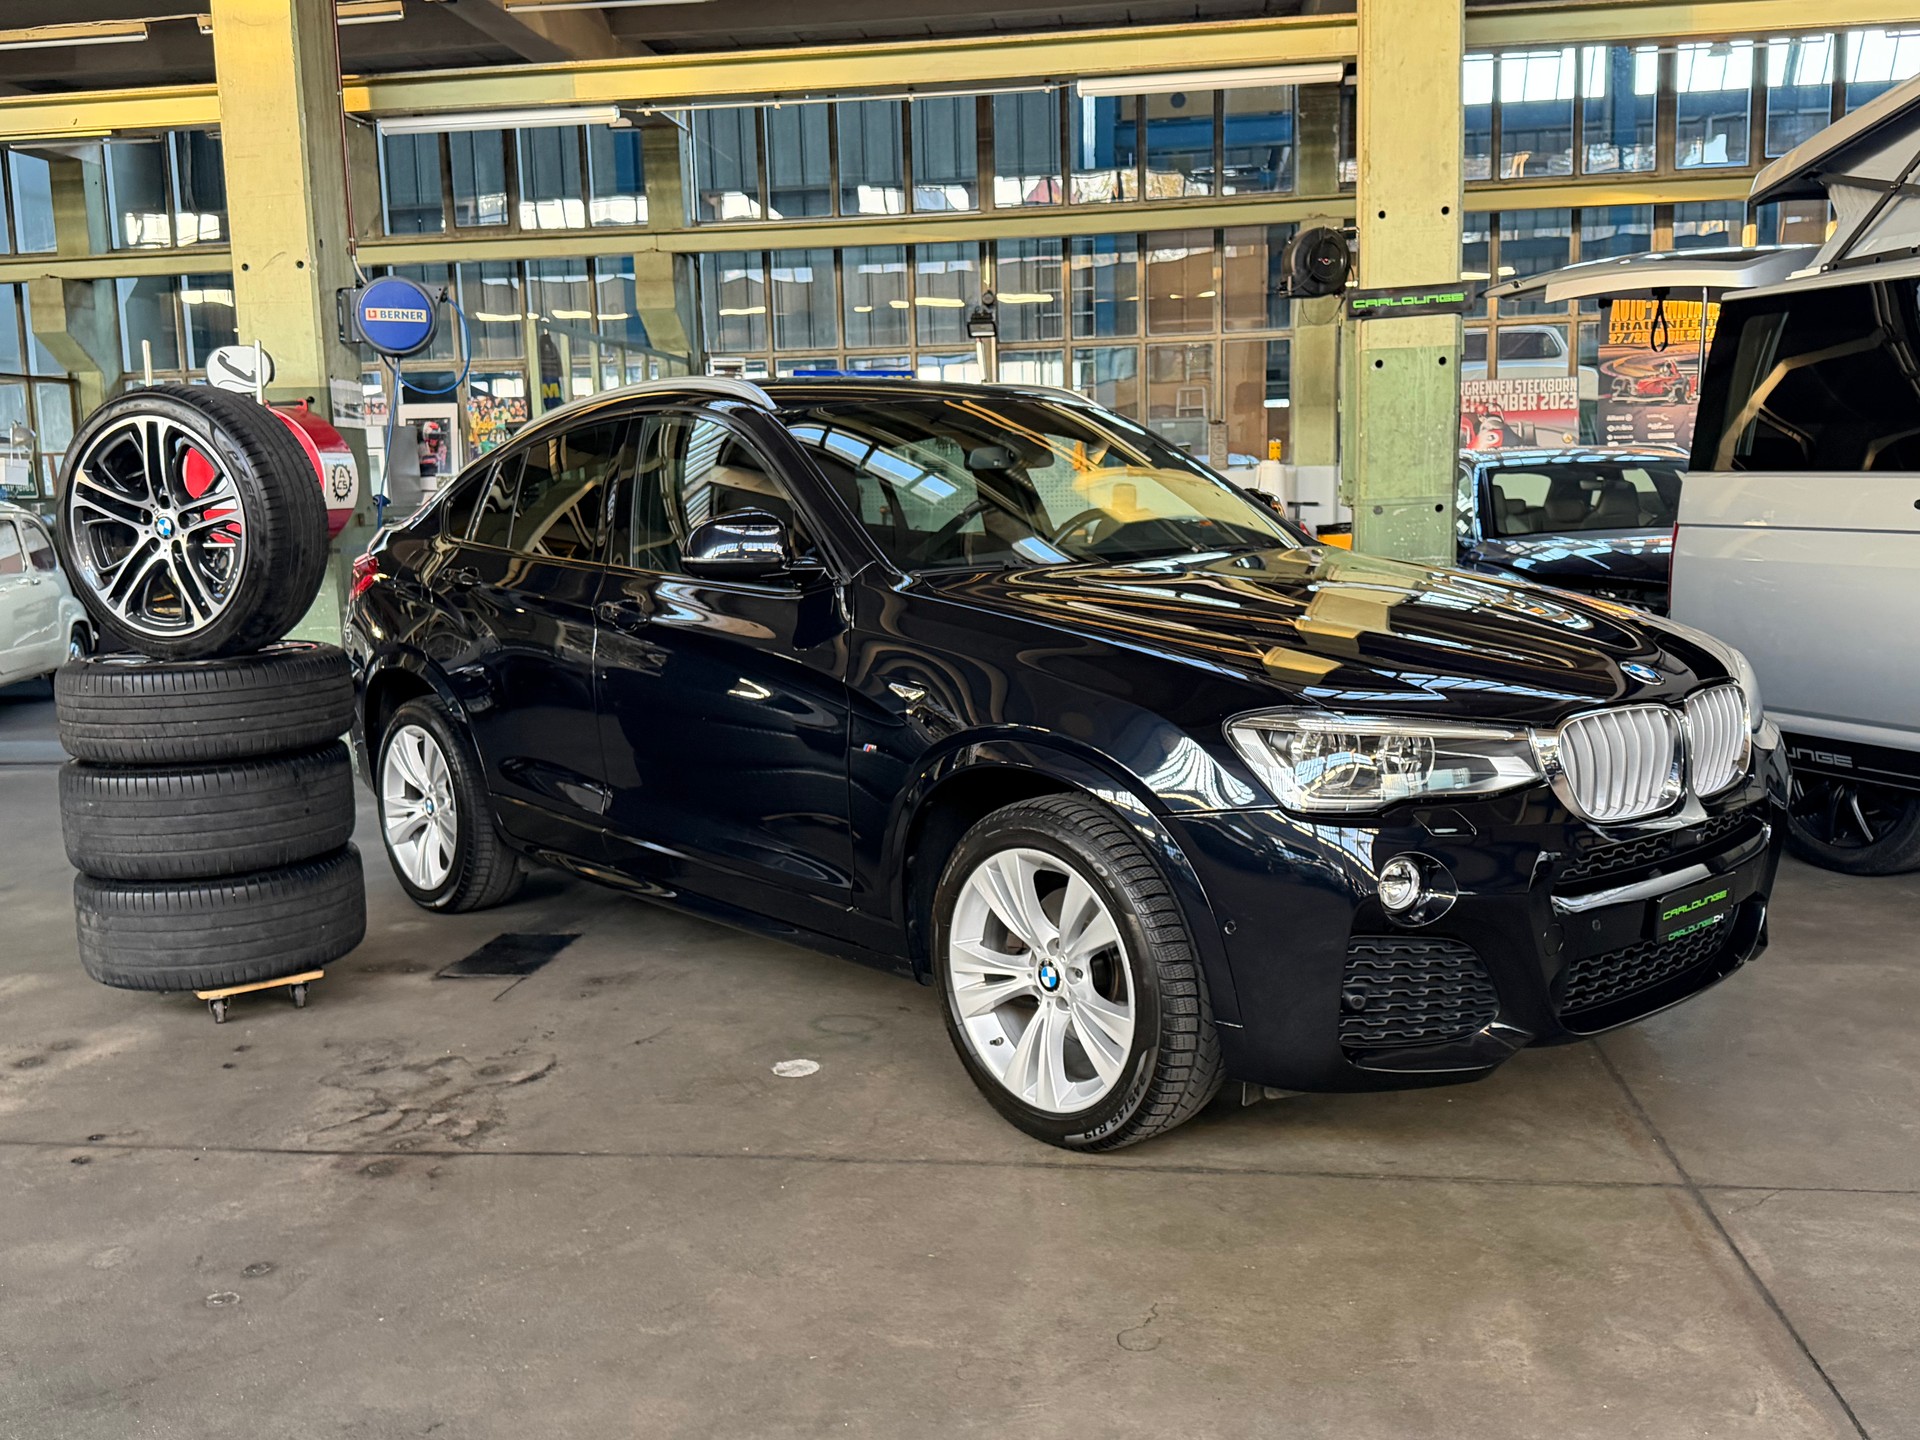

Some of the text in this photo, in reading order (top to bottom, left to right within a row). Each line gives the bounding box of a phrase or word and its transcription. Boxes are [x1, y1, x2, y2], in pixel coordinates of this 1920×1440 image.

[1352, 292, 1464, 309] CARLOUNGE
[380, 310, 423, 320] BERNER
[1515, 377, 1577, 393] STECKBORN
[1461, 392, 1577, 413] EPTEMBER 2023
[1663, 889, 1728, 920] CARLOUNGE
